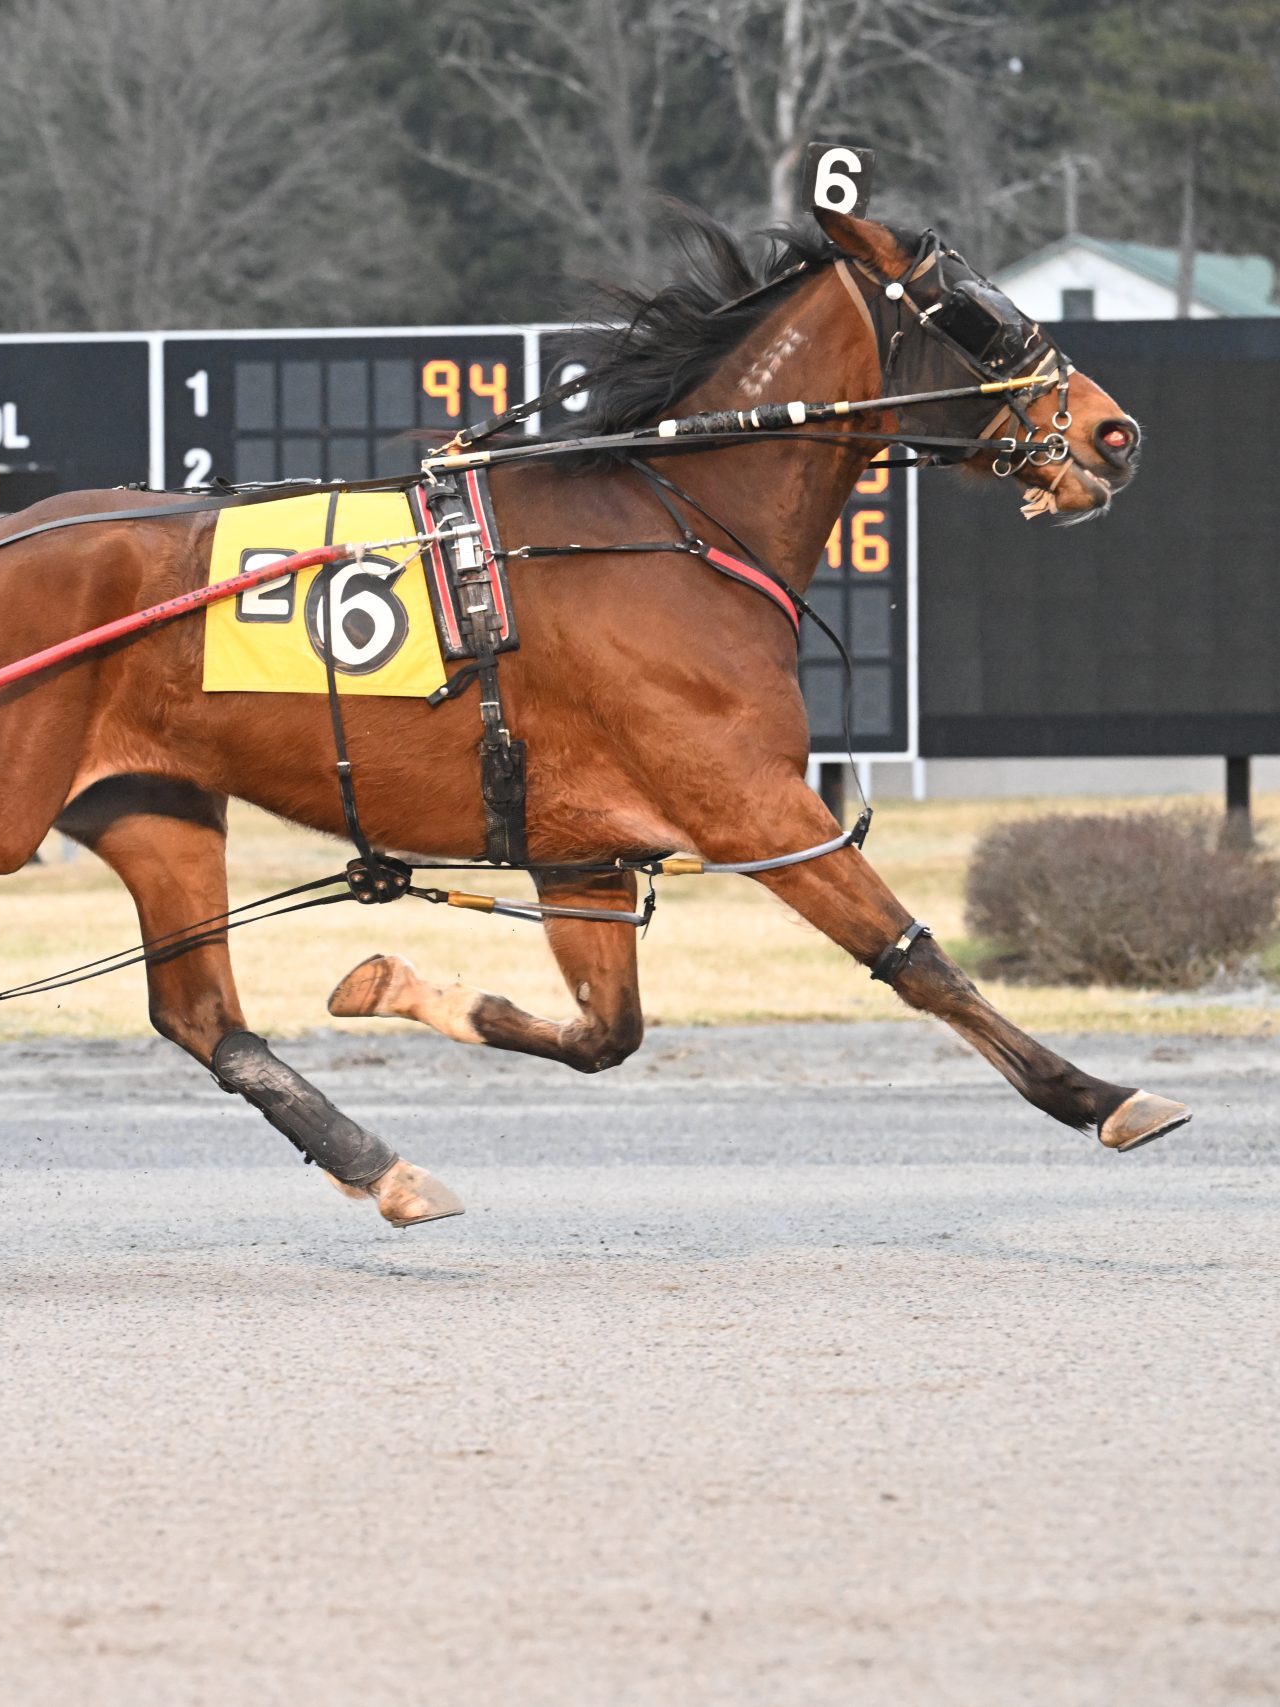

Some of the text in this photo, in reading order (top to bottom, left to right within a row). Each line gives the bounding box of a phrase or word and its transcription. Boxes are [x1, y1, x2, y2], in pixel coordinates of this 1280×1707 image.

[814, 147, 862, 214] 6
[185, 370, 209, 418] 1
[423, 360, 507, 418] 94
[183, 447, 212, 494] 2
[241, 552, 291, 614] 2
[316, 561, 396, 665] 6
